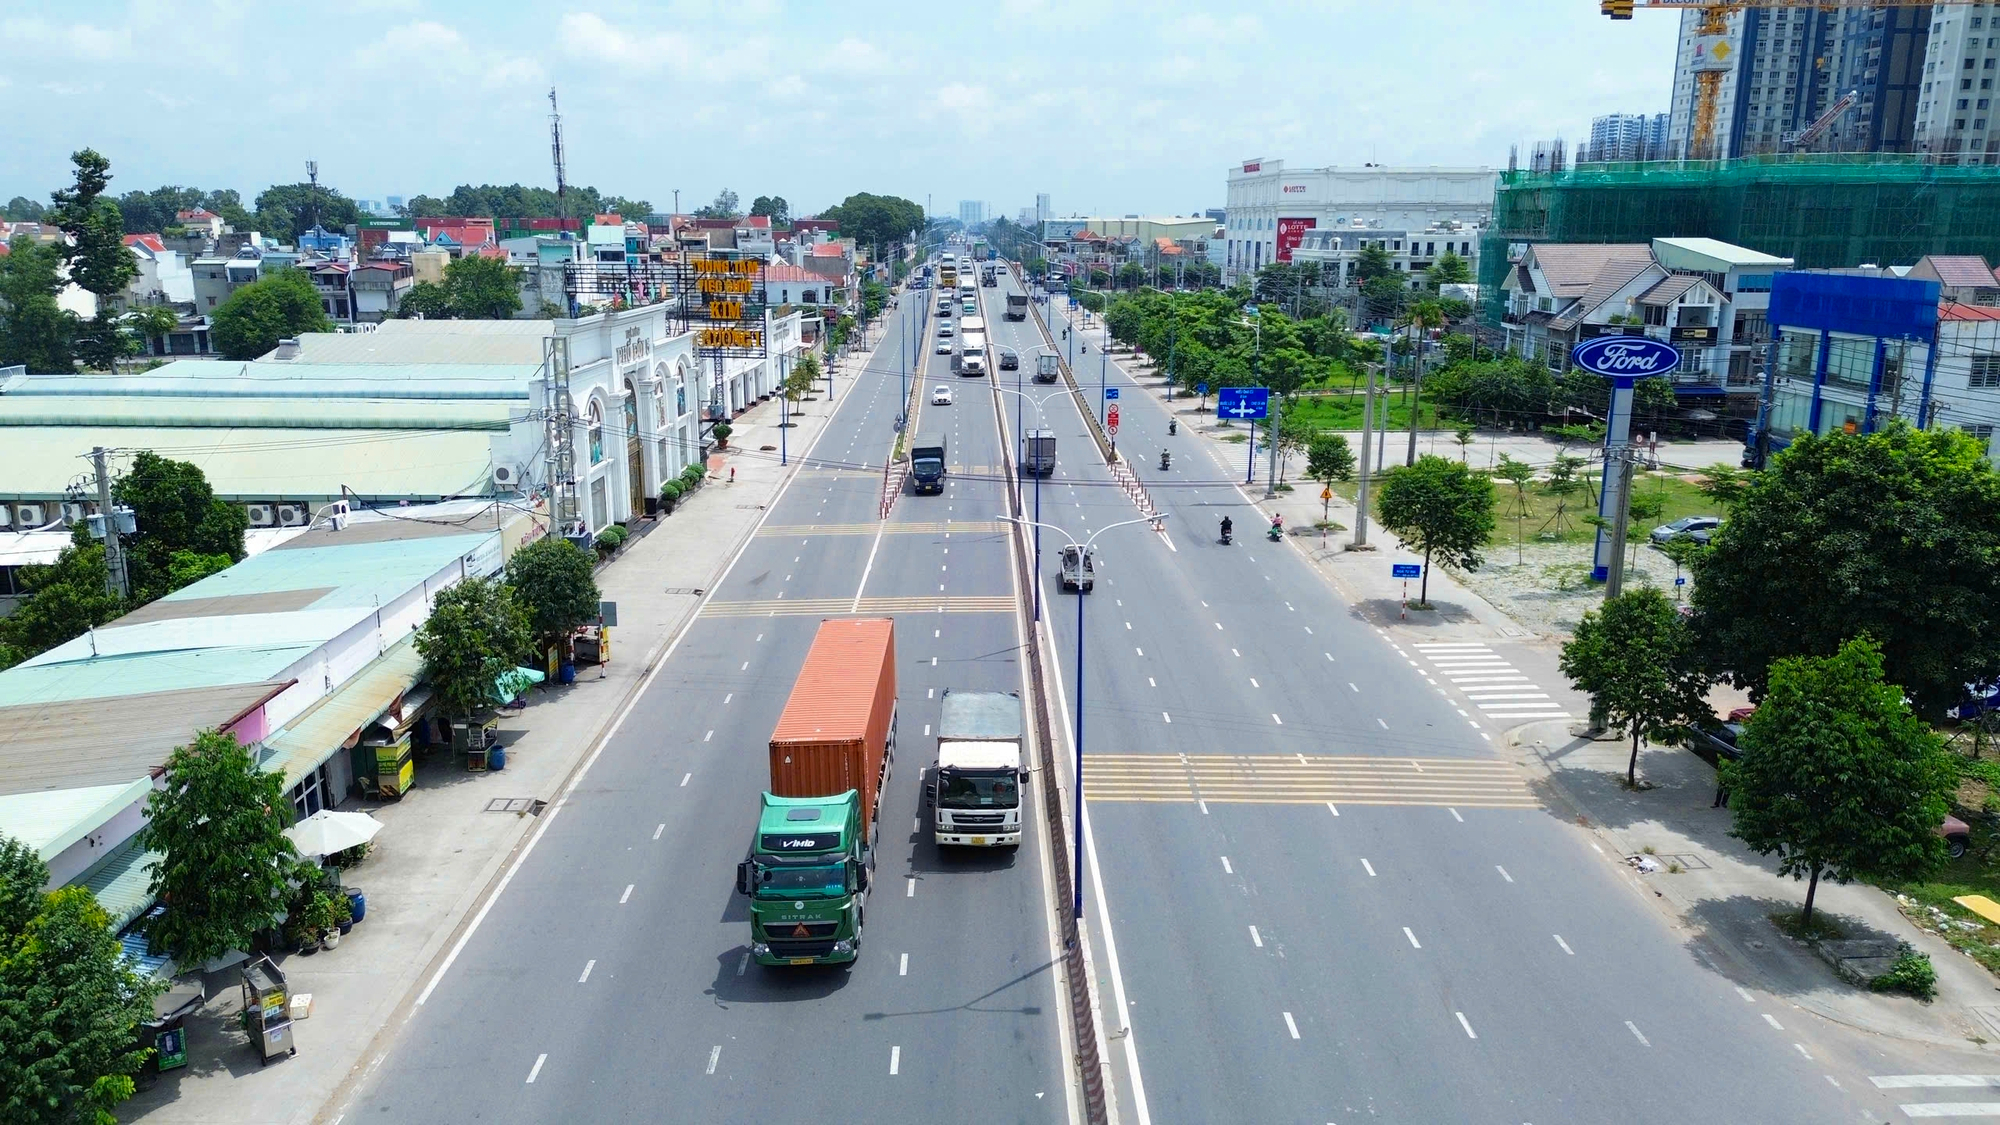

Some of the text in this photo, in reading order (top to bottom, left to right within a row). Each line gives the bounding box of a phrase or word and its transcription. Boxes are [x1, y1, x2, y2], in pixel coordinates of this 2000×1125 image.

[691, 259, 729, 273] TRUNG
[710, 302, 741, 319] KIM
[1597, 344, 1661, 370] Ford
